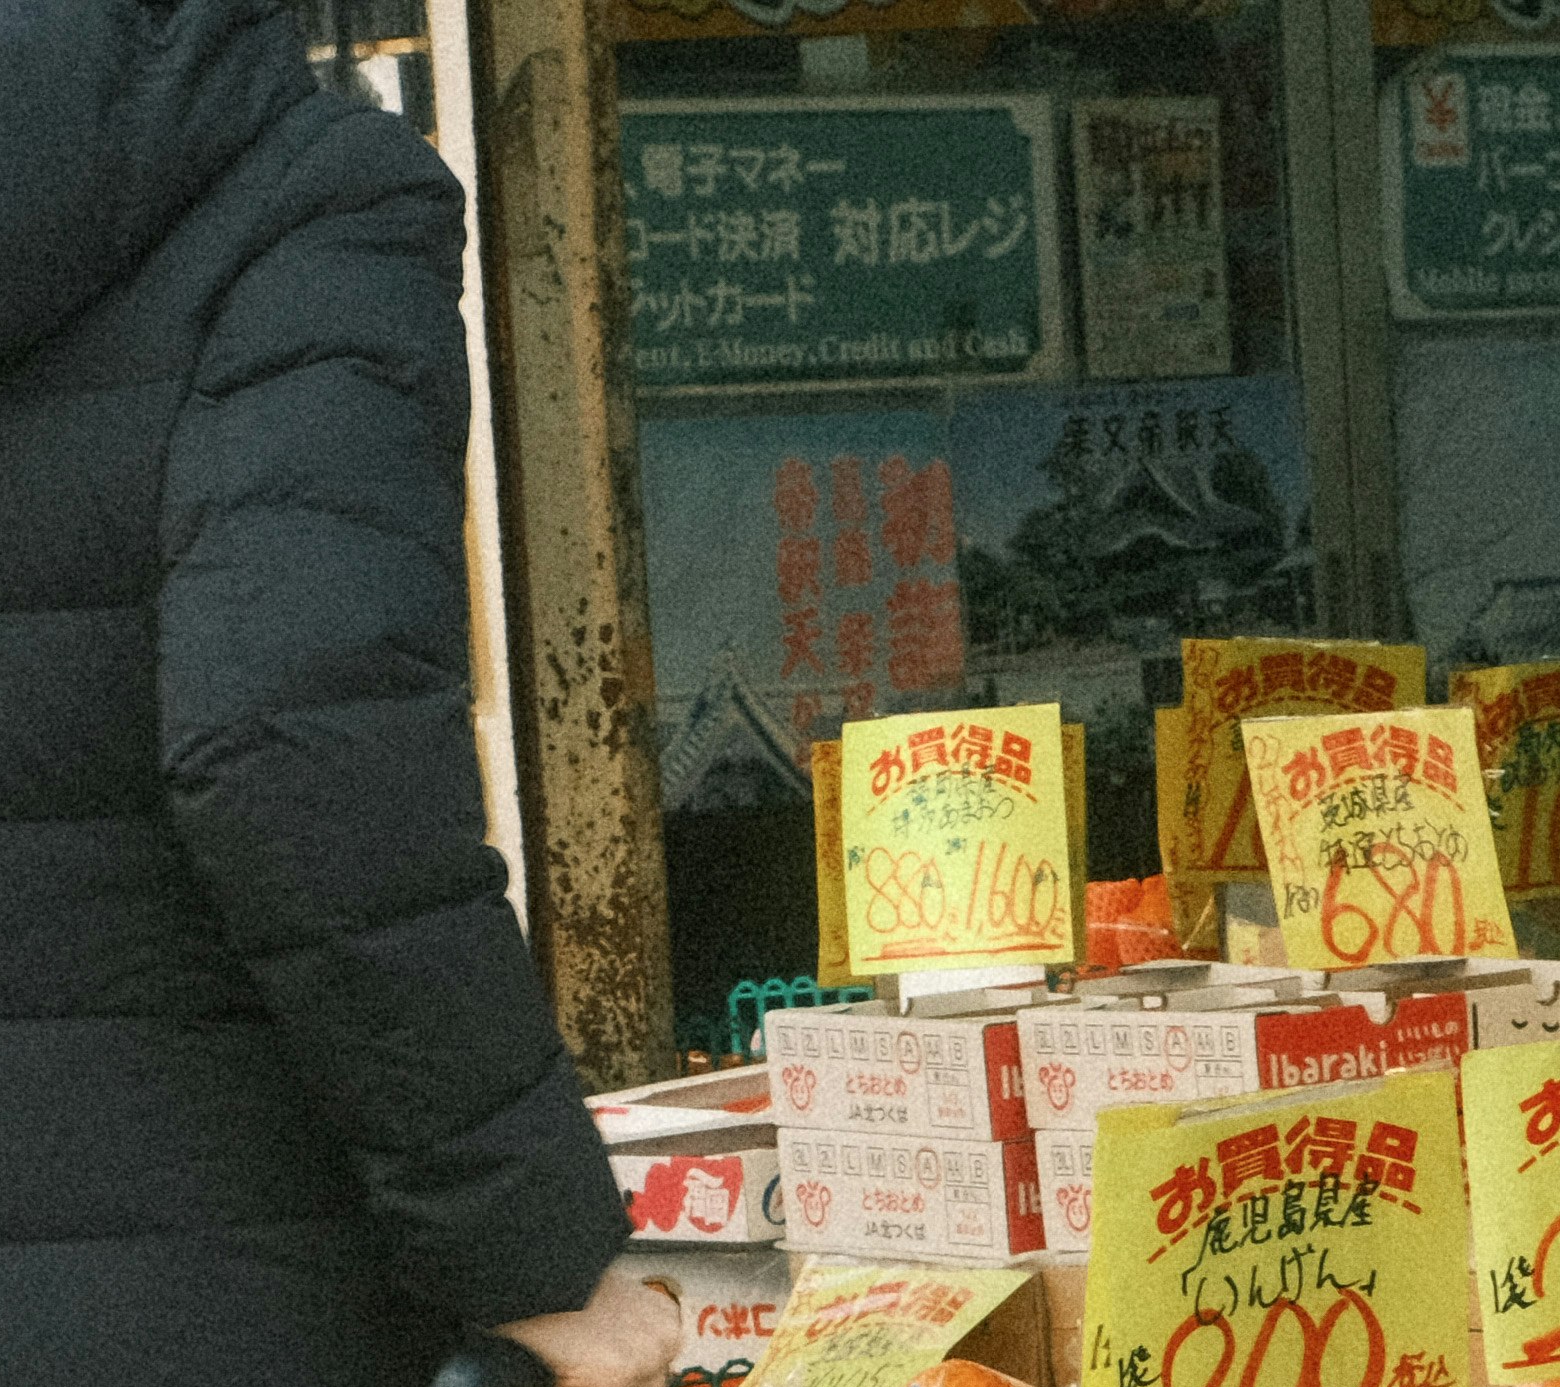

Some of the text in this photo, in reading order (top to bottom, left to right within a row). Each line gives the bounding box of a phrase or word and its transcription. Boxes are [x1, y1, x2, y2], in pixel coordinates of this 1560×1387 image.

[830, 192, 1029, 266] 対応レジ
[819, 333, 901, 364] Credit
[907, 330, 957, 362] and
[964, 327, 1029, 358] Cash
[1215, 651, 1397, 713] お買得品
[869, 723, 1033, 796] お買得品
[1282, 724, 1458, 801] お買得品
[1322, 843, 1465, 965] 680
[1396, 1021, 1460, 1042] いいもの
[845, 1072, 908, 1097] とちおとめ
[1106, 1068, 1176, 1093] とちおとめ
[1268, 1041, 1389, 1090] Ibaraki
[861, 1187, 926, 1214] とちおとめ
[1149, 1115, 1418, 1236] お買得品
